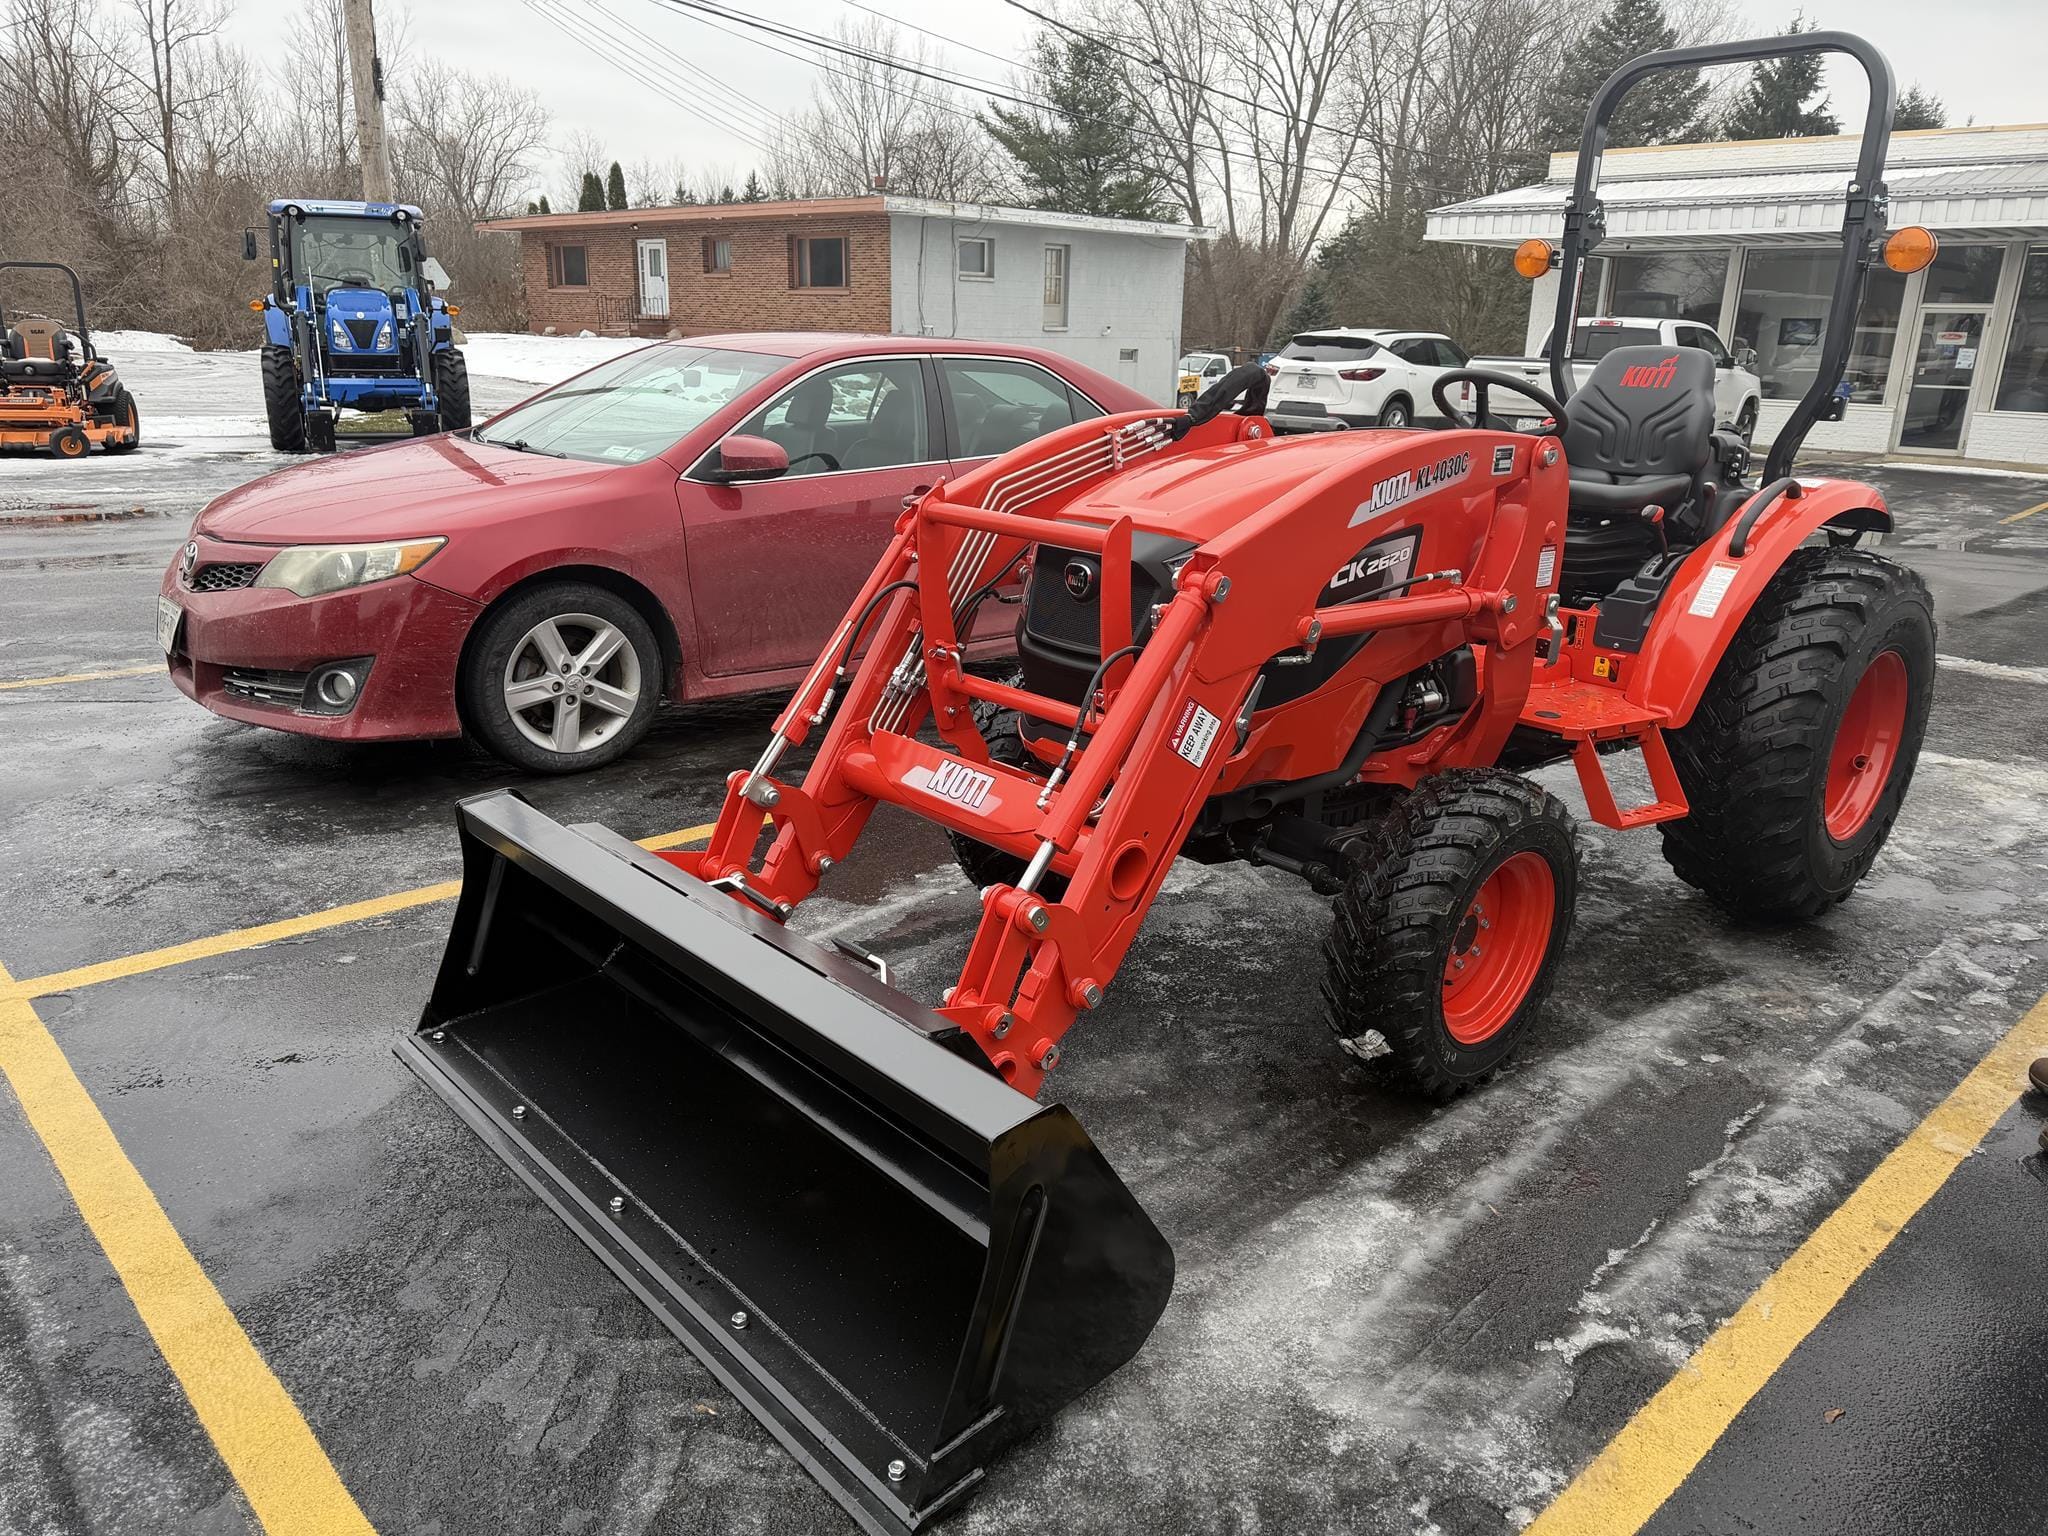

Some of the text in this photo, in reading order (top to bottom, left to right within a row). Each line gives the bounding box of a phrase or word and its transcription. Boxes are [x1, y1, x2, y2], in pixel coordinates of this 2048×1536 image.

[1619, 365, 1677, 388] KIOTI
[1369, 469, 1411, 512] KIOTI
[1415, 451, 1469, 491] KL4030C
[1175, 701, 1195, 737] WARNING
[1182, 709, 1208, 758] KEEP AWAY
[1200, 729, 1213, 750] working
[1209, 718, 1217, 730] area
[927, 758, 997, 808] KIOTI
